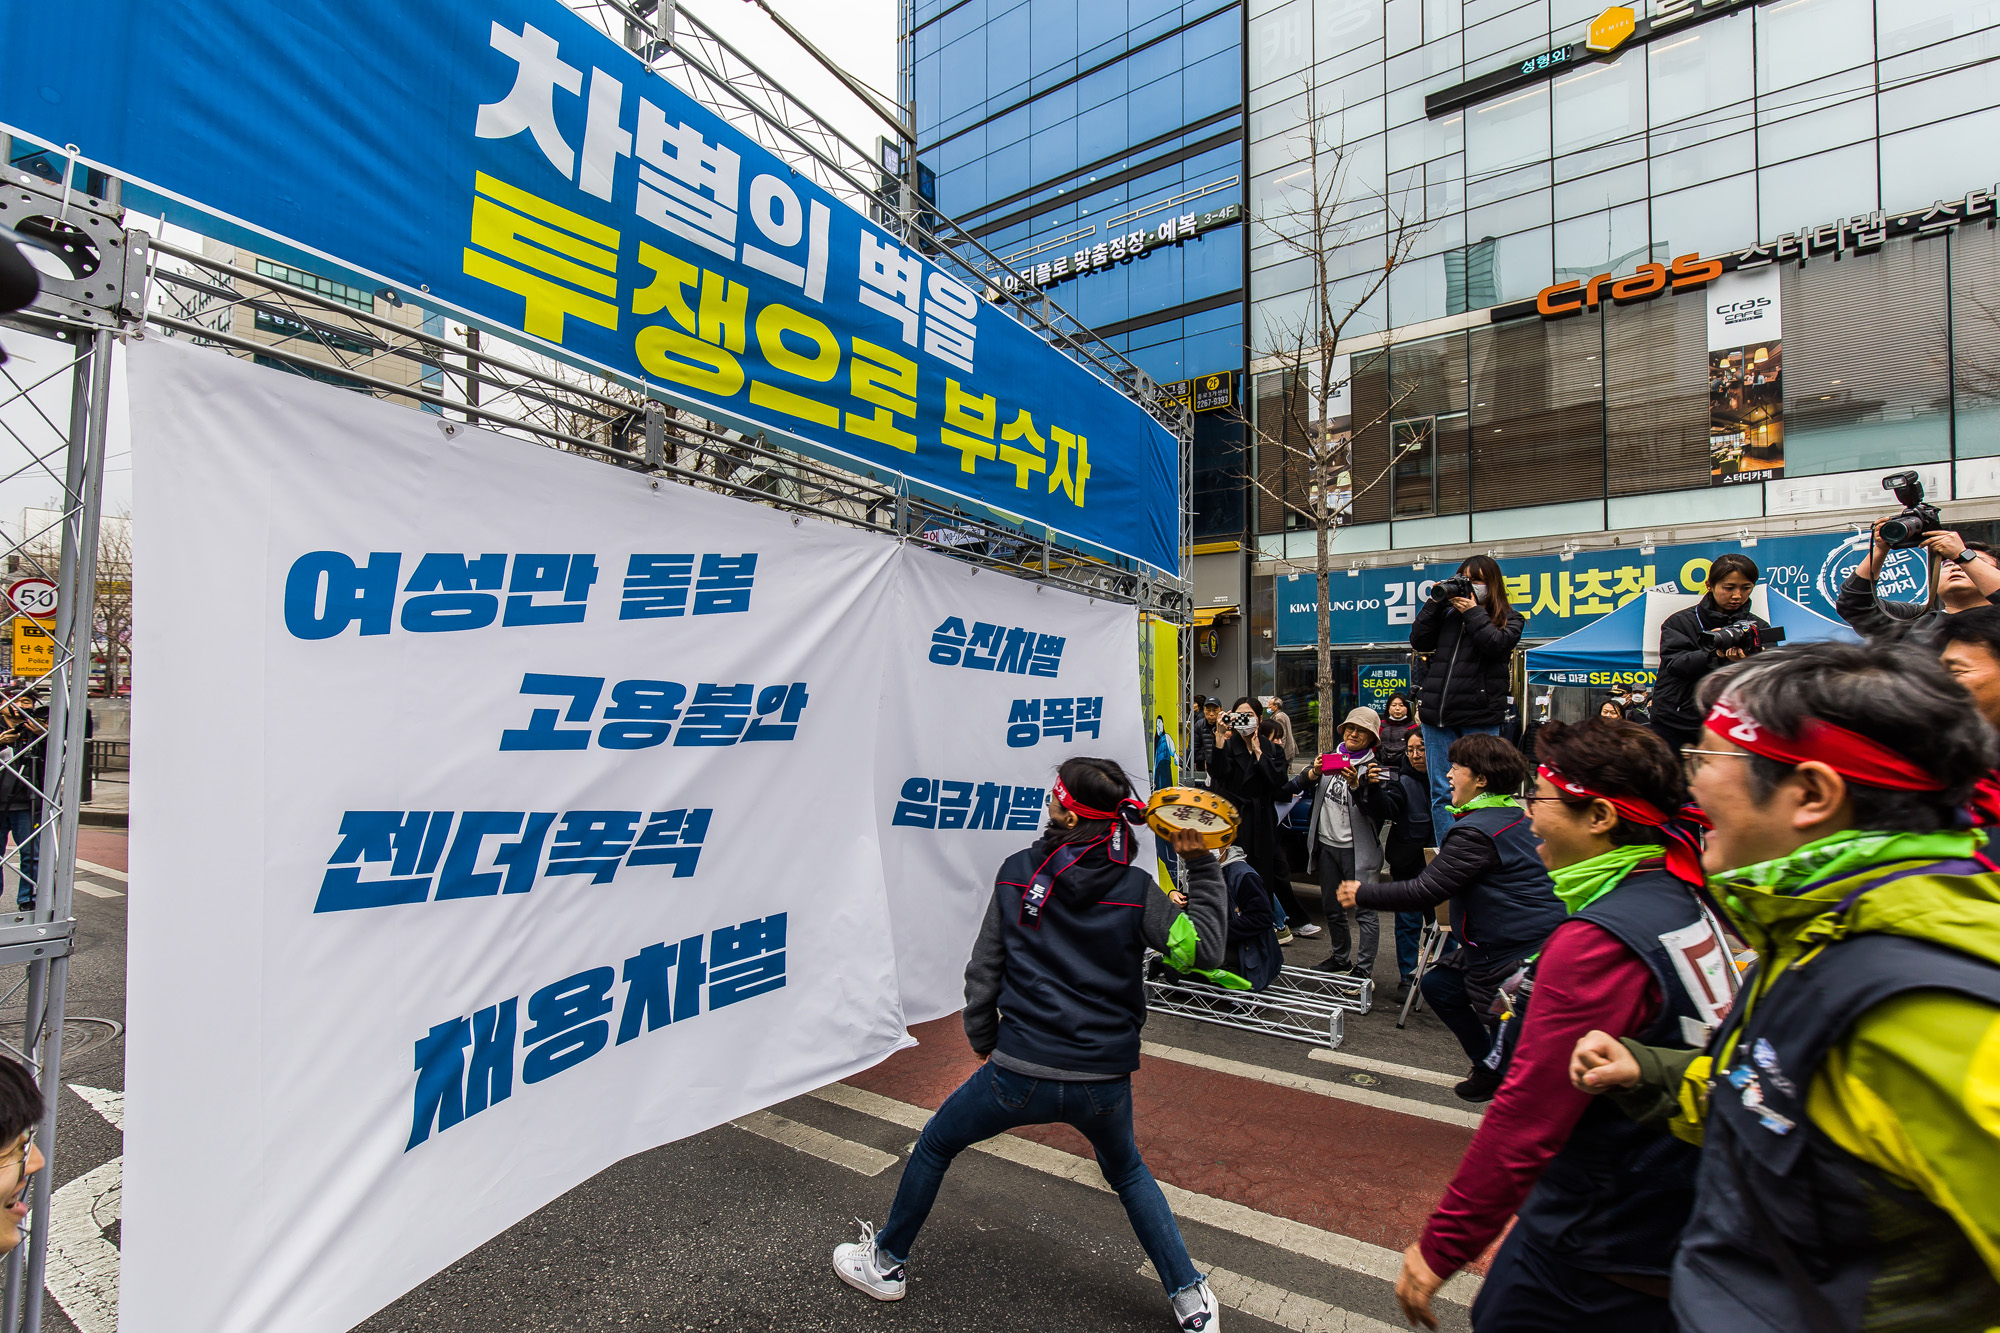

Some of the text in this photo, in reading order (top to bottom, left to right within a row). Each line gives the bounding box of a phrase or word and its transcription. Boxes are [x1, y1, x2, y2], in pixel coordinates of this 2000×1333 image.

[1521, 45, 1571, 74] 성형외
[474, 20, 978, 374] 차별의 벽을
[1203, 204, 1235, 224] 3-4F
[1537, 252, 1723, 316] cras
[1716, 297, 1771, 314] cras
[463, 170, 1091, 507] 투쟁으로 부수자
[1208, 378, 1218, 389] 2F
[1197, 395, 1229, 409] 2267-9393
[1723, 469, 1772, 483] 스터디카페
[20, 589, 53, 607] 50
[285, 551, 758, 639] 여성만 돌봄
[1290, 603, 1310, 613] KIM
[1356, 598, 1380, 611] JOO
[929, 617, 1065, 677] 승진차별
[1363, 678, 1407, 688] SEASON
[1549, 671, 1657, 684] 시즌 마감 SEASON
[1374, 688, 1395, 697] OFF
[500, 673, 808, 751] 고용불안
[1007, 697, 1103, 747] 성폭력
[892, 778, 1044, 830] 임금차별
[314, 809, 713, 913] 젠더폭력
[404, 912, 787, 1153] 채용차별
